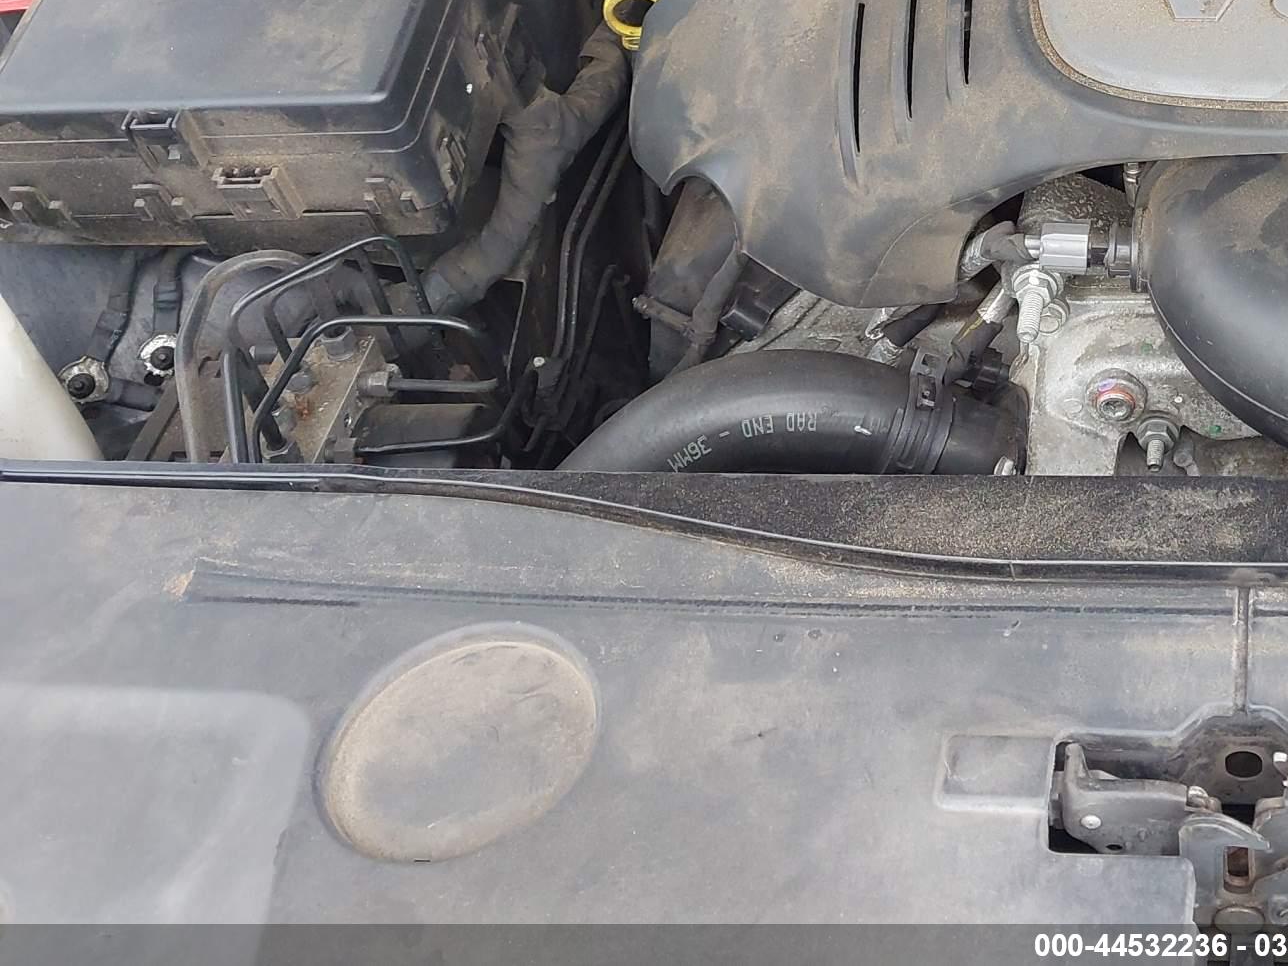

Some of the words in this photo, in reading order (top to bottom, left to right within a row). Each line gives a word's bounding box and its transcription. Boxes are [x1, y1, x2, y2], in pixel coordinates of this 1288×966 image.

[741, 414, 774, 438] END
[786, 411, 817, 432] RAD
[666, 434, 713, 474] 36MM
